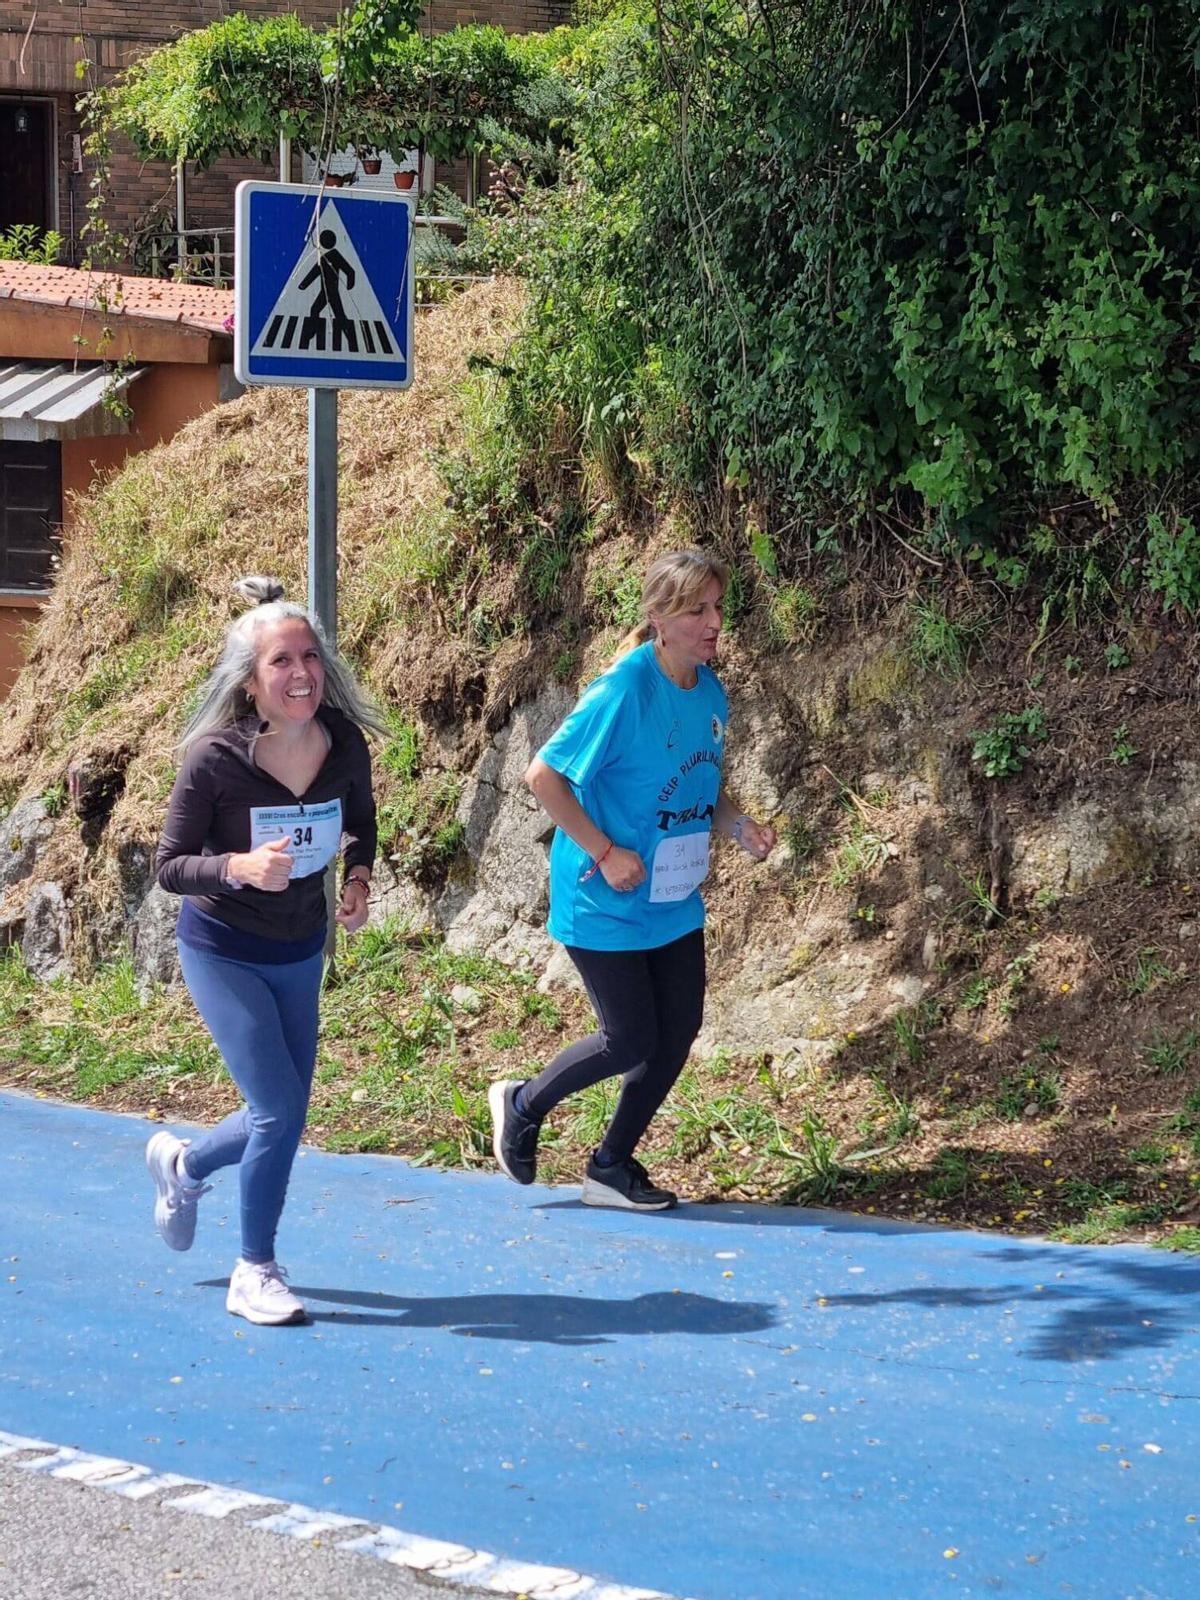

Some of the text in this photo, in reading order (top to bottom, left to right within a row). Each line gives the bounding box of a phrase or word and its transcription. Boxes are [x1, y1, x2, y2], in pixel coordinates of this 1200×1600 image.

[657, 749, 720, 802] CEIP PLURILIN
[293, 826, 313, 847] 34
